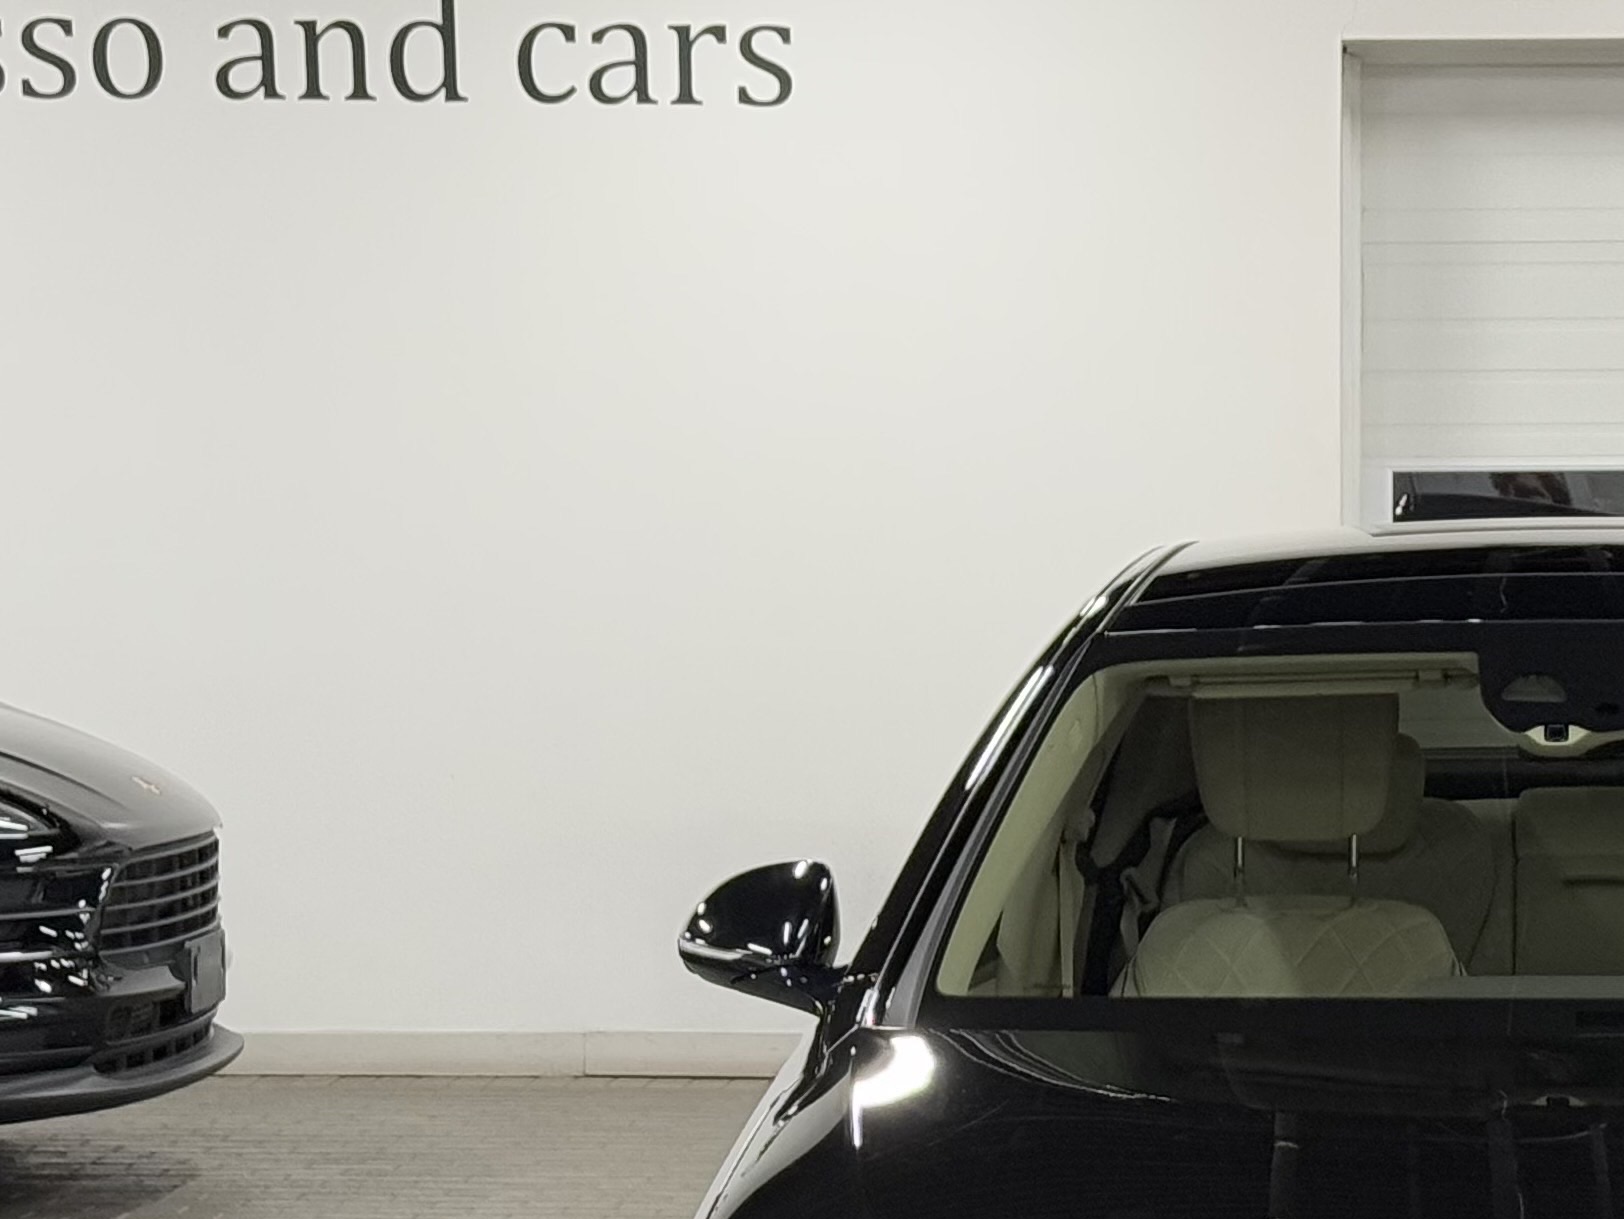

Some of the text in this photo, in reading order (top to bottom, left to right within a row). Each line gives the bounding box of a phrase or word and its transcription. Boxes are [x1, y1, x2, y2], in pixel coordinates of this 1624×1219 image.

[0, 0, 792, 106] so and cars
